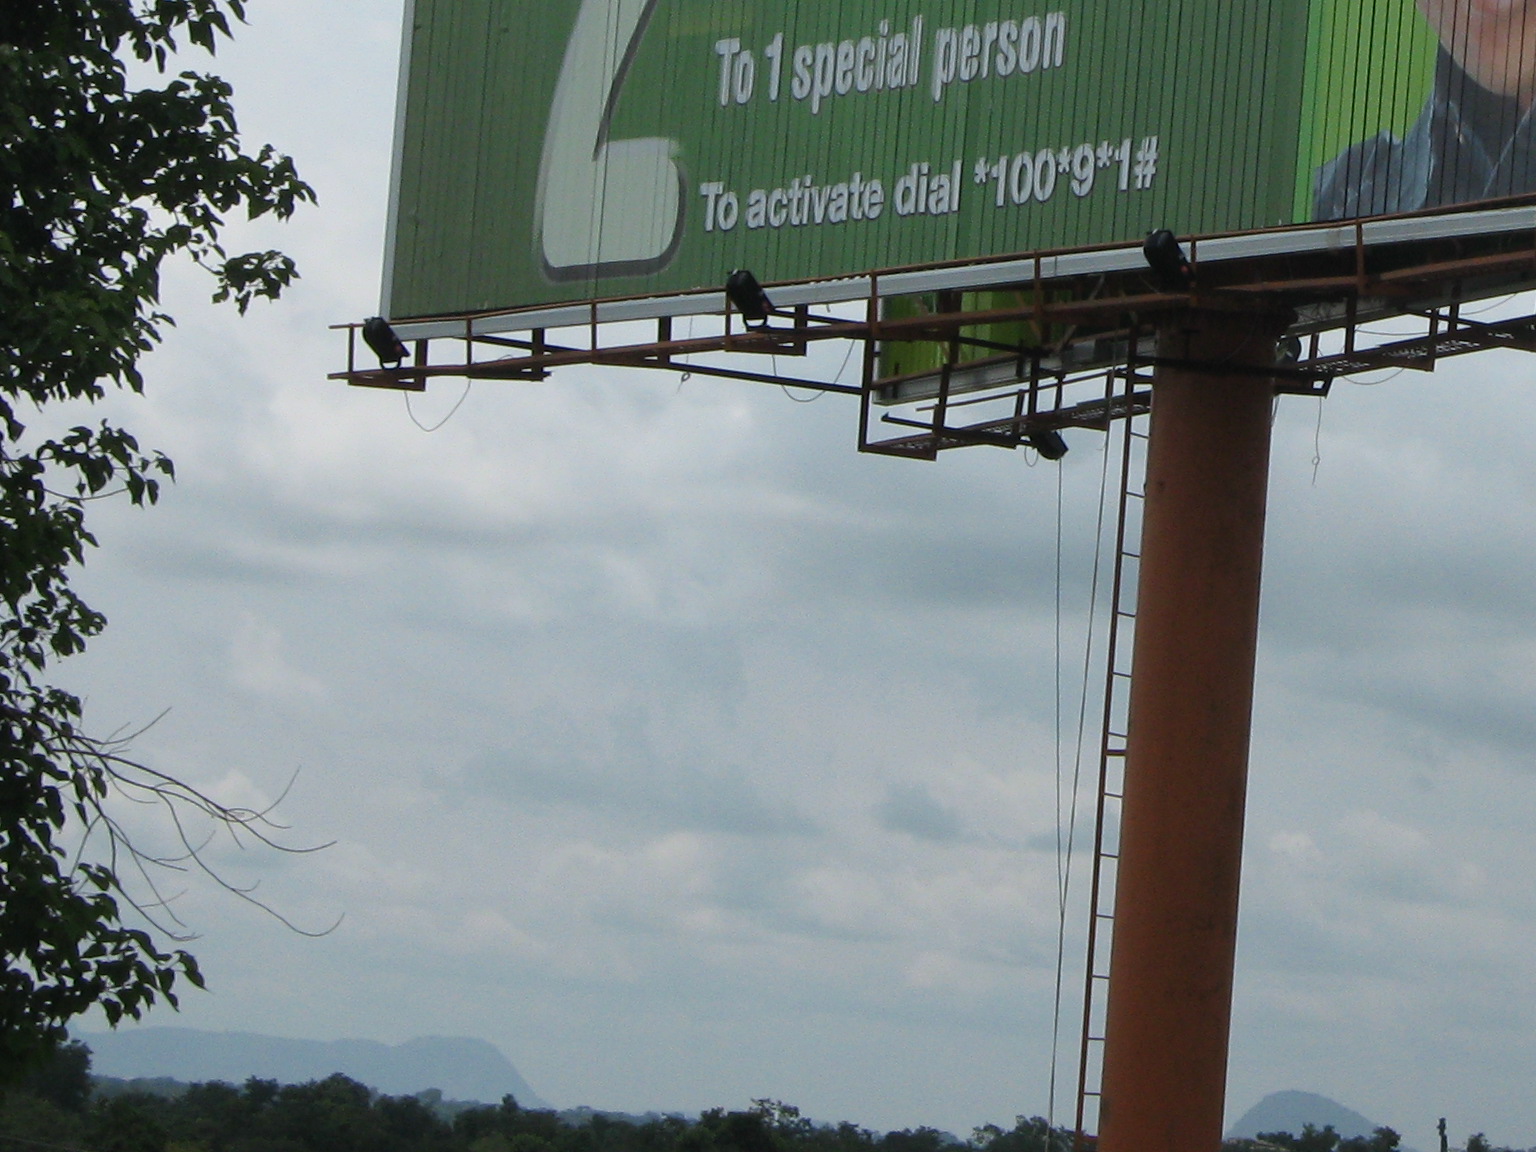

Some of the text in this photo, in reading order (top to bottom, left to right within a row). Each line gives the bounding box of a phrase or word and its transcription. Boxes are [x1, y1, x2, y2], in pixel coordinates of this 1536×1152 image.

[715, 10, 1067, 115] To 1 special person
[701, 181, 739, 232] To
[746, 170, 885, 230] activate
[893, 160, 963, 215] dial
